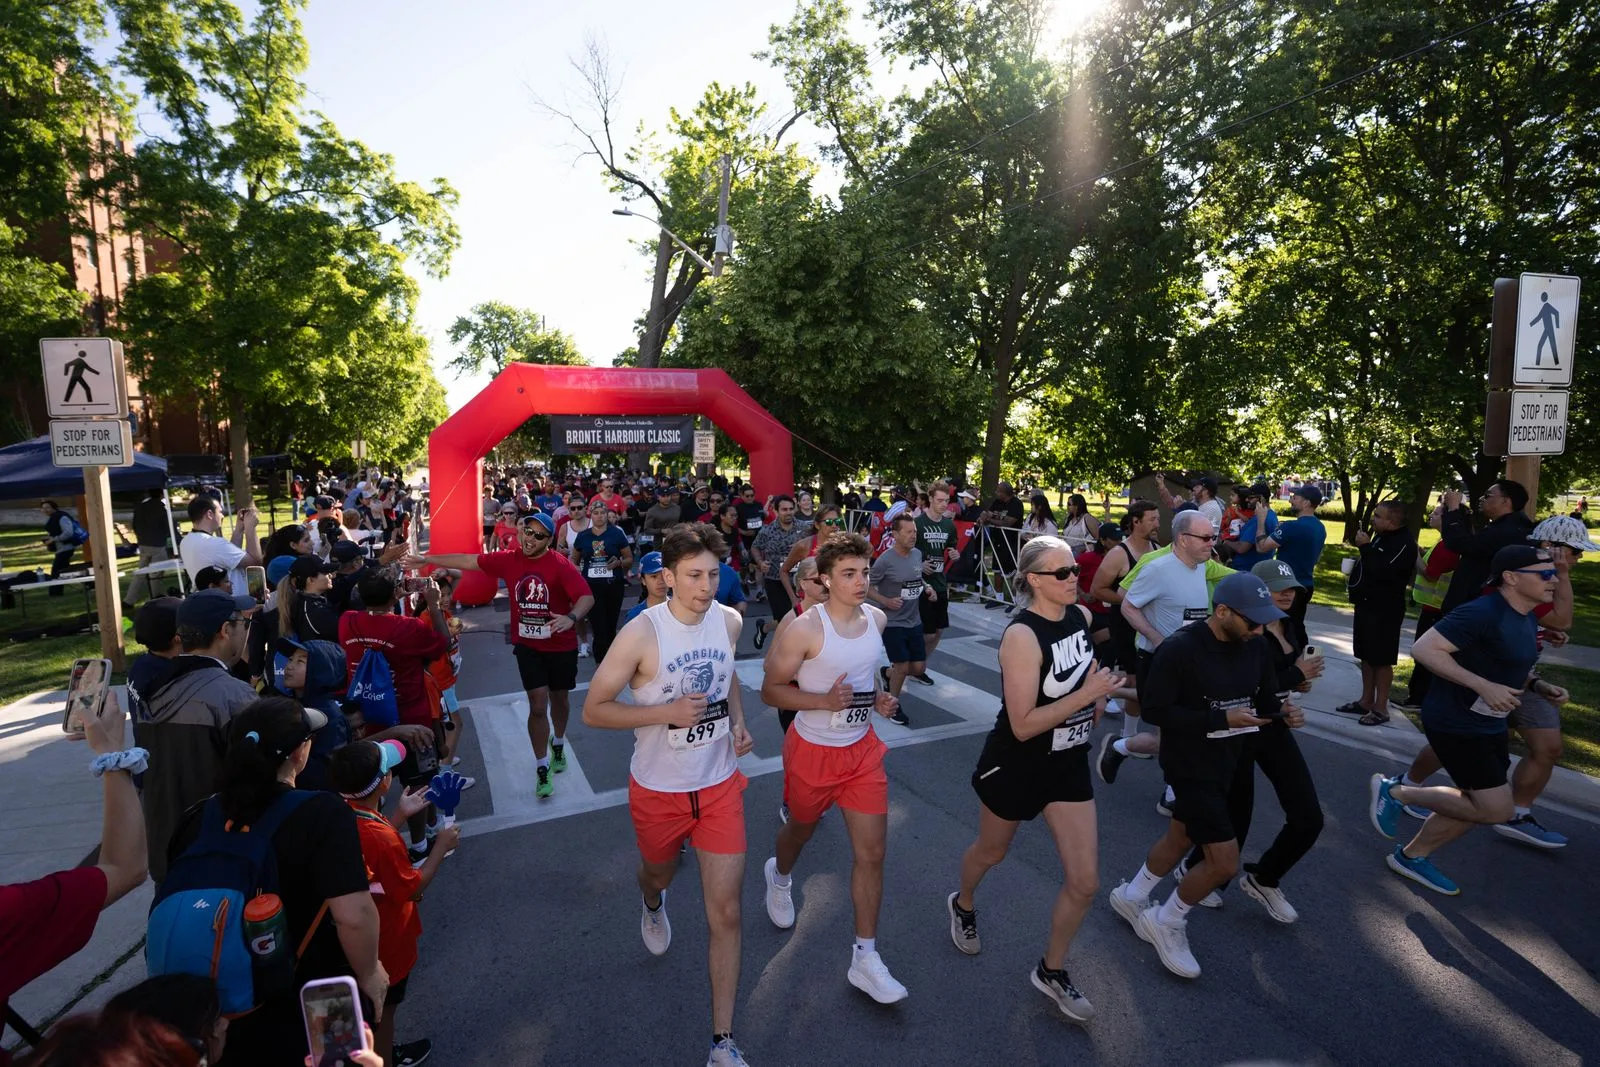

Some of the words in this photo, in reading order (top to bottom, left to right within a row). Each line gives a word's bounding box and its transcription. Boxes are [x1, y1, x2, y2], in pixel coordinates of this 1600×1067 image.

[1521, 404, 1541, 420] STOP
[1543, 404, 1559, 420] FOR
[63, 429, 87, 442] STOP
[91, 429, 110, 441] FOR
[566, 430, 602, 445] BRONTE
[604, 429, 646, 444] HARBOUR
[647, 429, 681, 444] CLASSIC
[1512, 425, 1563, 442] PEDESTRIANS
[56, 444, 121, 458] PEDESTRIANS
[907, 587, 920, 597] 358
[524, 625, 542, 636] 394
[665, 647, 727, 674] GEORGIAN
[1051, 629, 1091, 676] NIKE
[846, 708, 870, 724] 698
[686, 721, 716, 744] 699
[1067, 720, 1091, 742] 244
